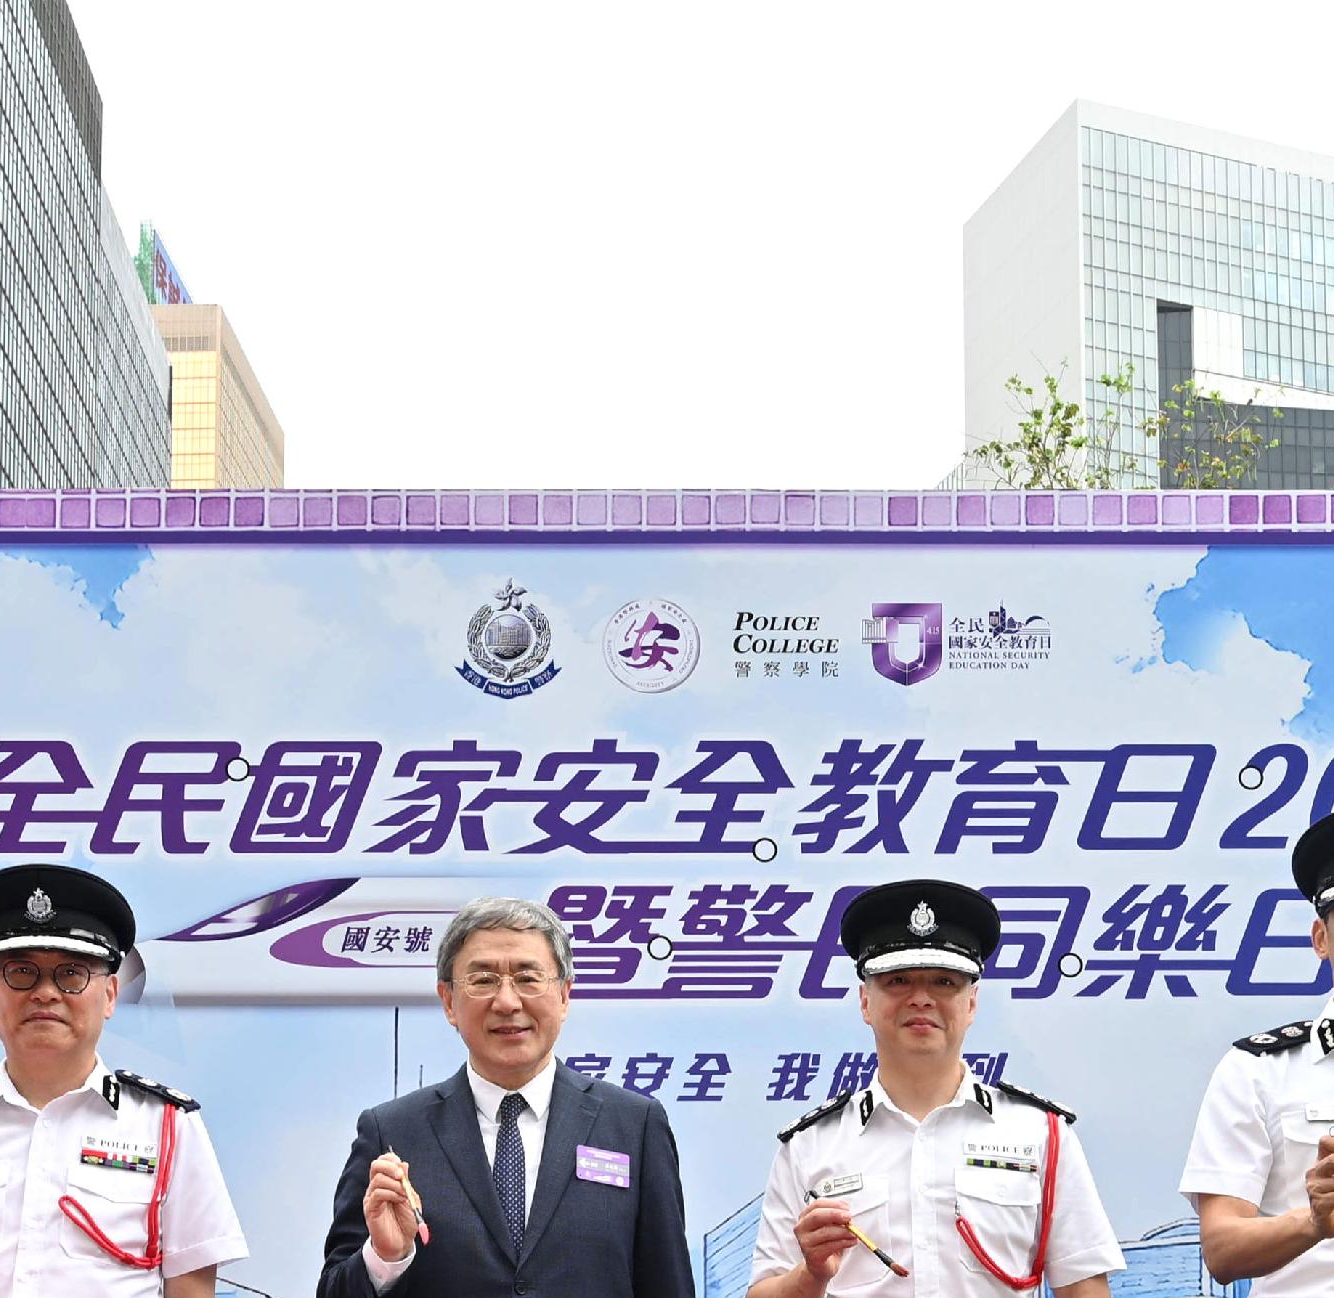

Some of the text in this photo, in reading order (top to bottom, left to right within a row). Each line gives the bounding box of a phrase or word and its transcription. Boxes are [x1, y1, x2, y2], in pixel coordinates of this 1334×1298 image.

[733, 611, 820, 632] POLICE
[948, 616, 985, 634] 全民
[733, 633, 840, 655] COLLEGE
[948, 634, 1052, 650] 國家安全教育日
[948, 651, 1051, 660] NATIONAL SECURITY
[734, 660, 839, 679] 警察學院
[948, 661, 1030, 670] EDUCATION DAY
[341, 926, 434, 954] 國安號
